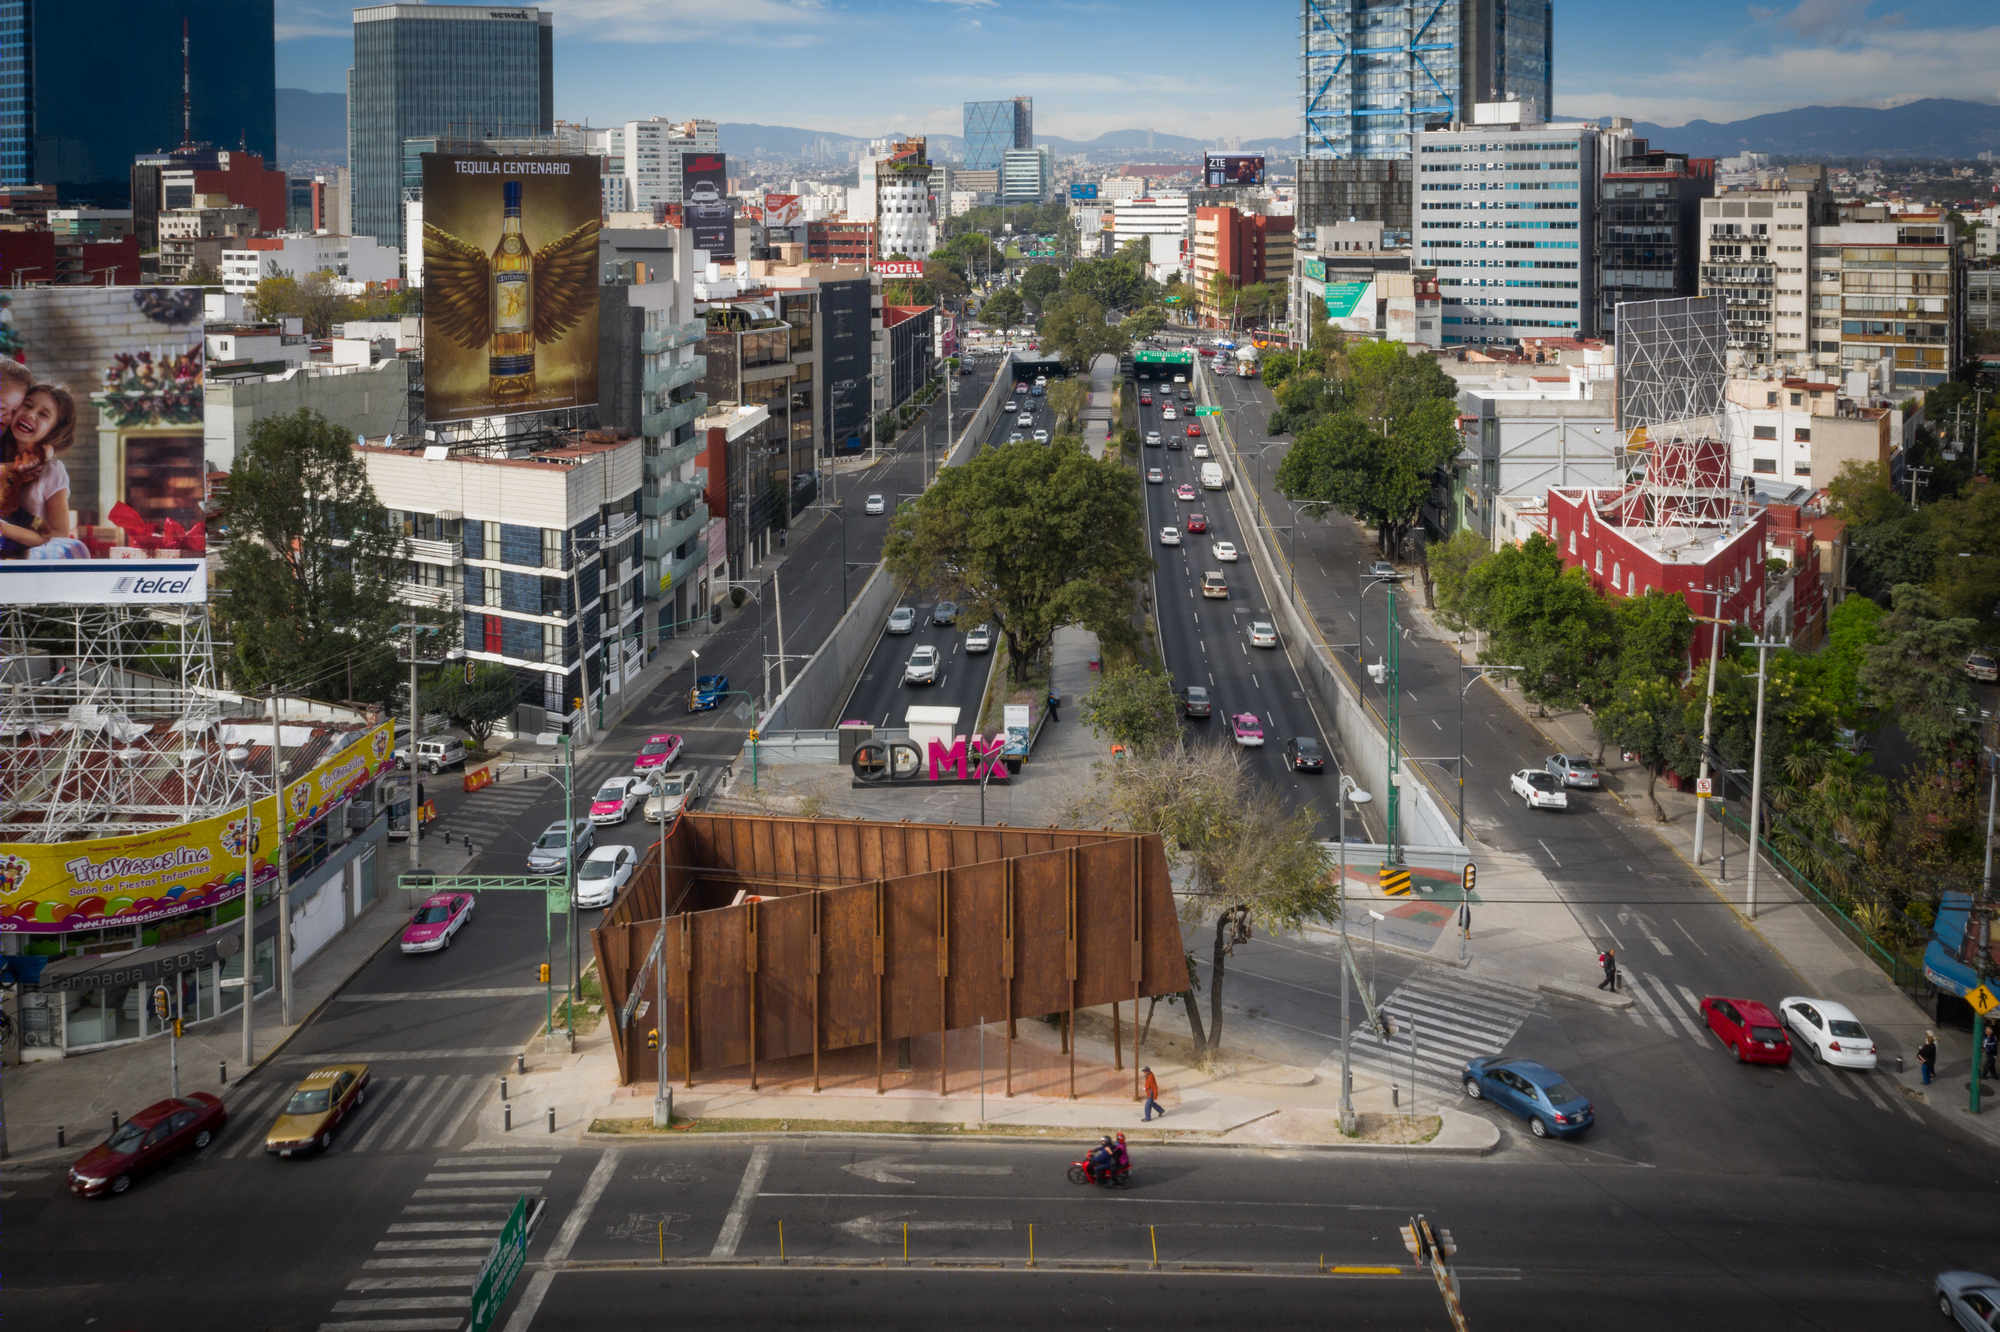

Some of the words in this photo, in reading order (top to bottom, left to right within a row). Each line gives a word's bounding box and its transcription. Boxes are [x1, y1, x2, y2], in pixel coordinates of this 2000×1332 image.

[490, 9, 529, 19] wework
[454, 160, 501, 175] TEQUILA
[503, 162, 570, 175] CENTENARIO
[1209, 158, 1225, 168] ZTE
[877, 263, 920, 274] HOTEL
[498, 274, 527, 282] CENTENARIO
[133, 577, 192, 593] telcel
[852, 734, 1009, 781] CDMX
[158, 831, 191, 843] Aprendizaje
[65, 851, 177, 883] Traviesos
[177, 845, 212, 866] Inc.
[69, 885, 98, 897] Salón
[102, 883, 115, 893] de
[118, 878, 157, 891] Fiestas
[160, 865, 210, 883] Infantiles
[73, 903, 188, 930] www.traviesosinc.com
[50, 967, 143, 989] Farmacia
[155, 948, 206, 974] ISOS
[491, 1228, 517, 1283] PUEBLA
